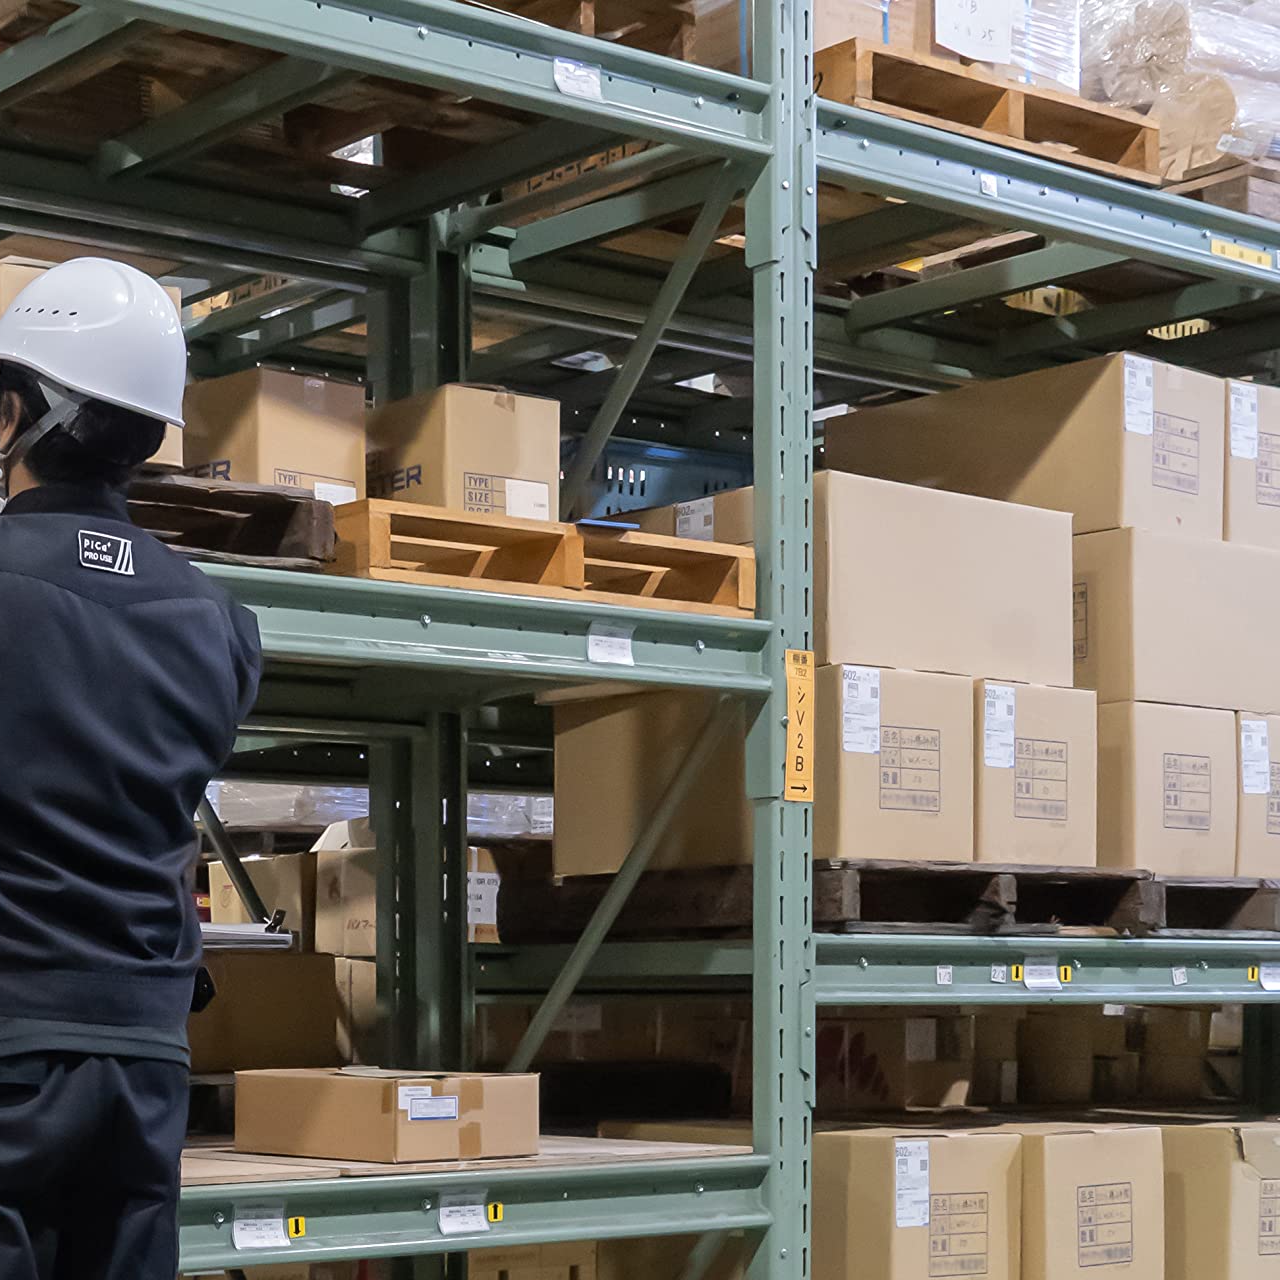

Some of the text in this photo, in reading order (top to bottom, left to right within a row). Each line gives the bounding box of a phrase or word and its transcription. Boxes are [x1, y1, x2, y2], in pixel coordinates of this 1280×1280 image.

[467, 475, 490, 489] TYPE
[467, 490, 490, 504] SIZE
[84, 550, 113, 563] PRO USE
[795, 686, 806, 772] シV2B
